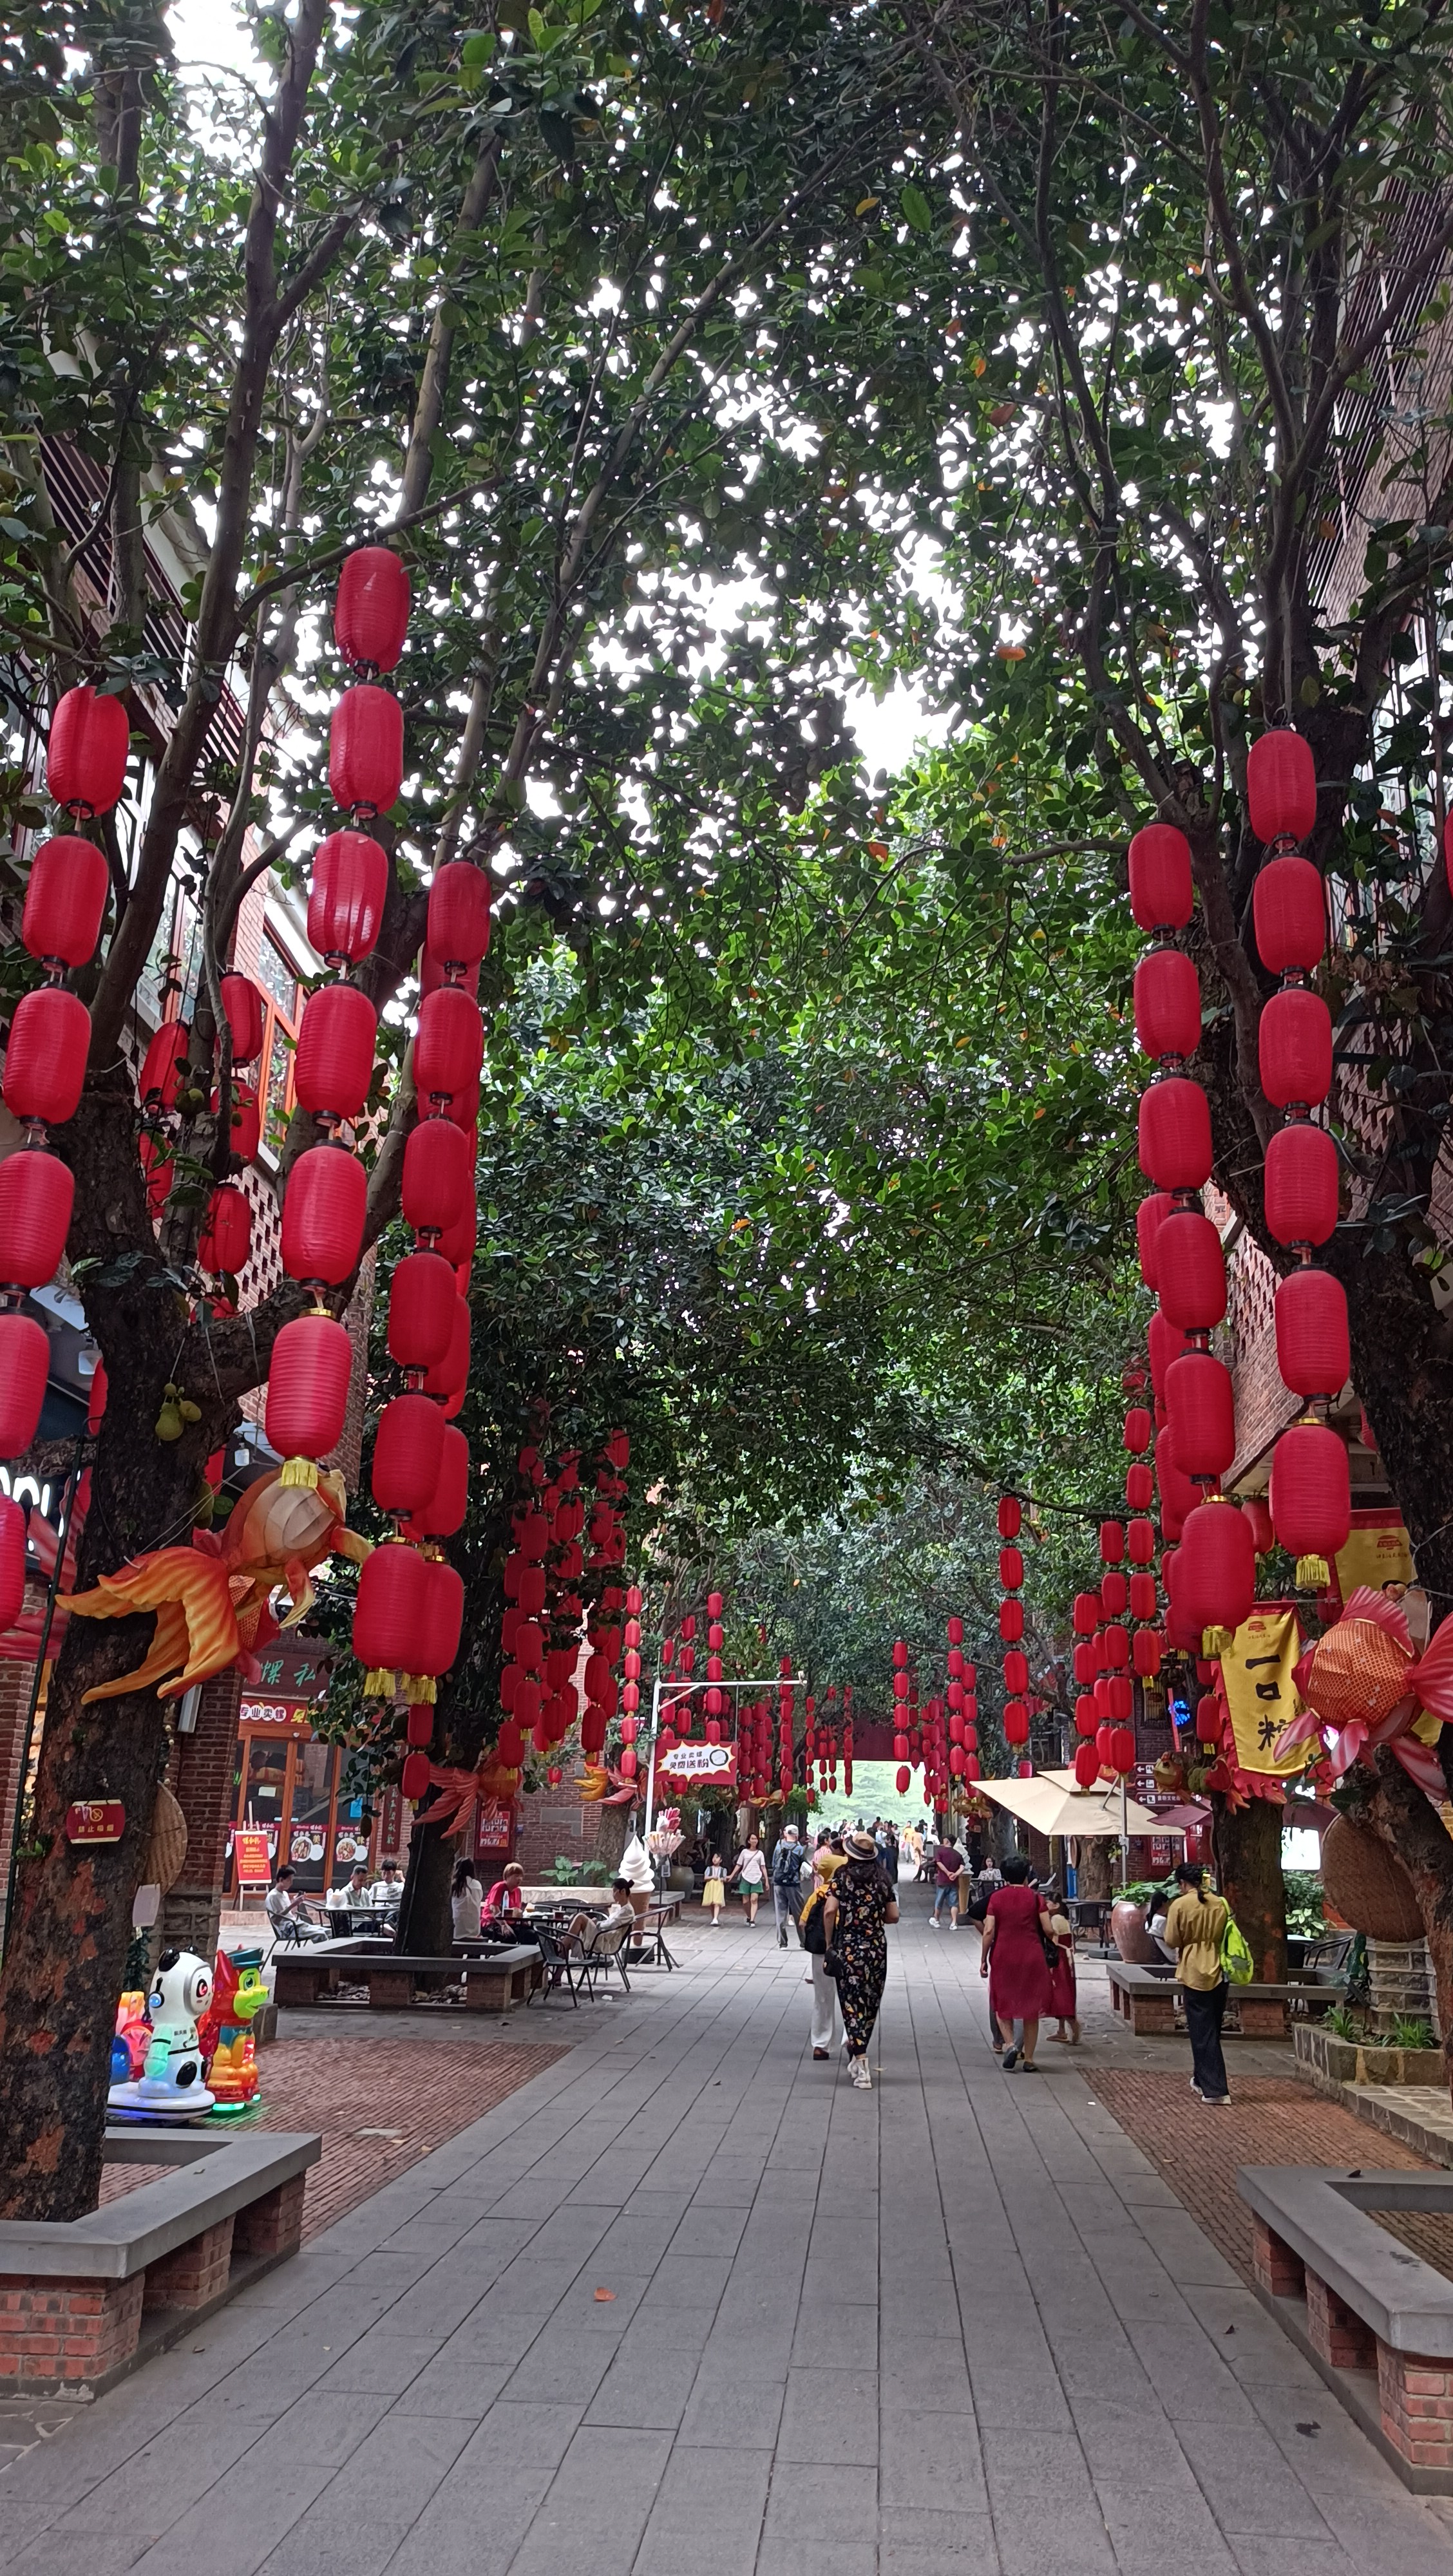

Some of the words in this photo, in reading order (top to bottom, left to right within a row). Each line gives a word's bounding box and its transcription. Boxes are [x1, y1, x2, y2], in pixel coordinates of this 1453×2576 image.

[240, 1706, 285, 1720] 专业卖螺
[290, 1708, 309, 1724] 免
[673, 1751, 703, 1760] 专业卖螺
[669, 1758, 709, 1770] 免费送粉
